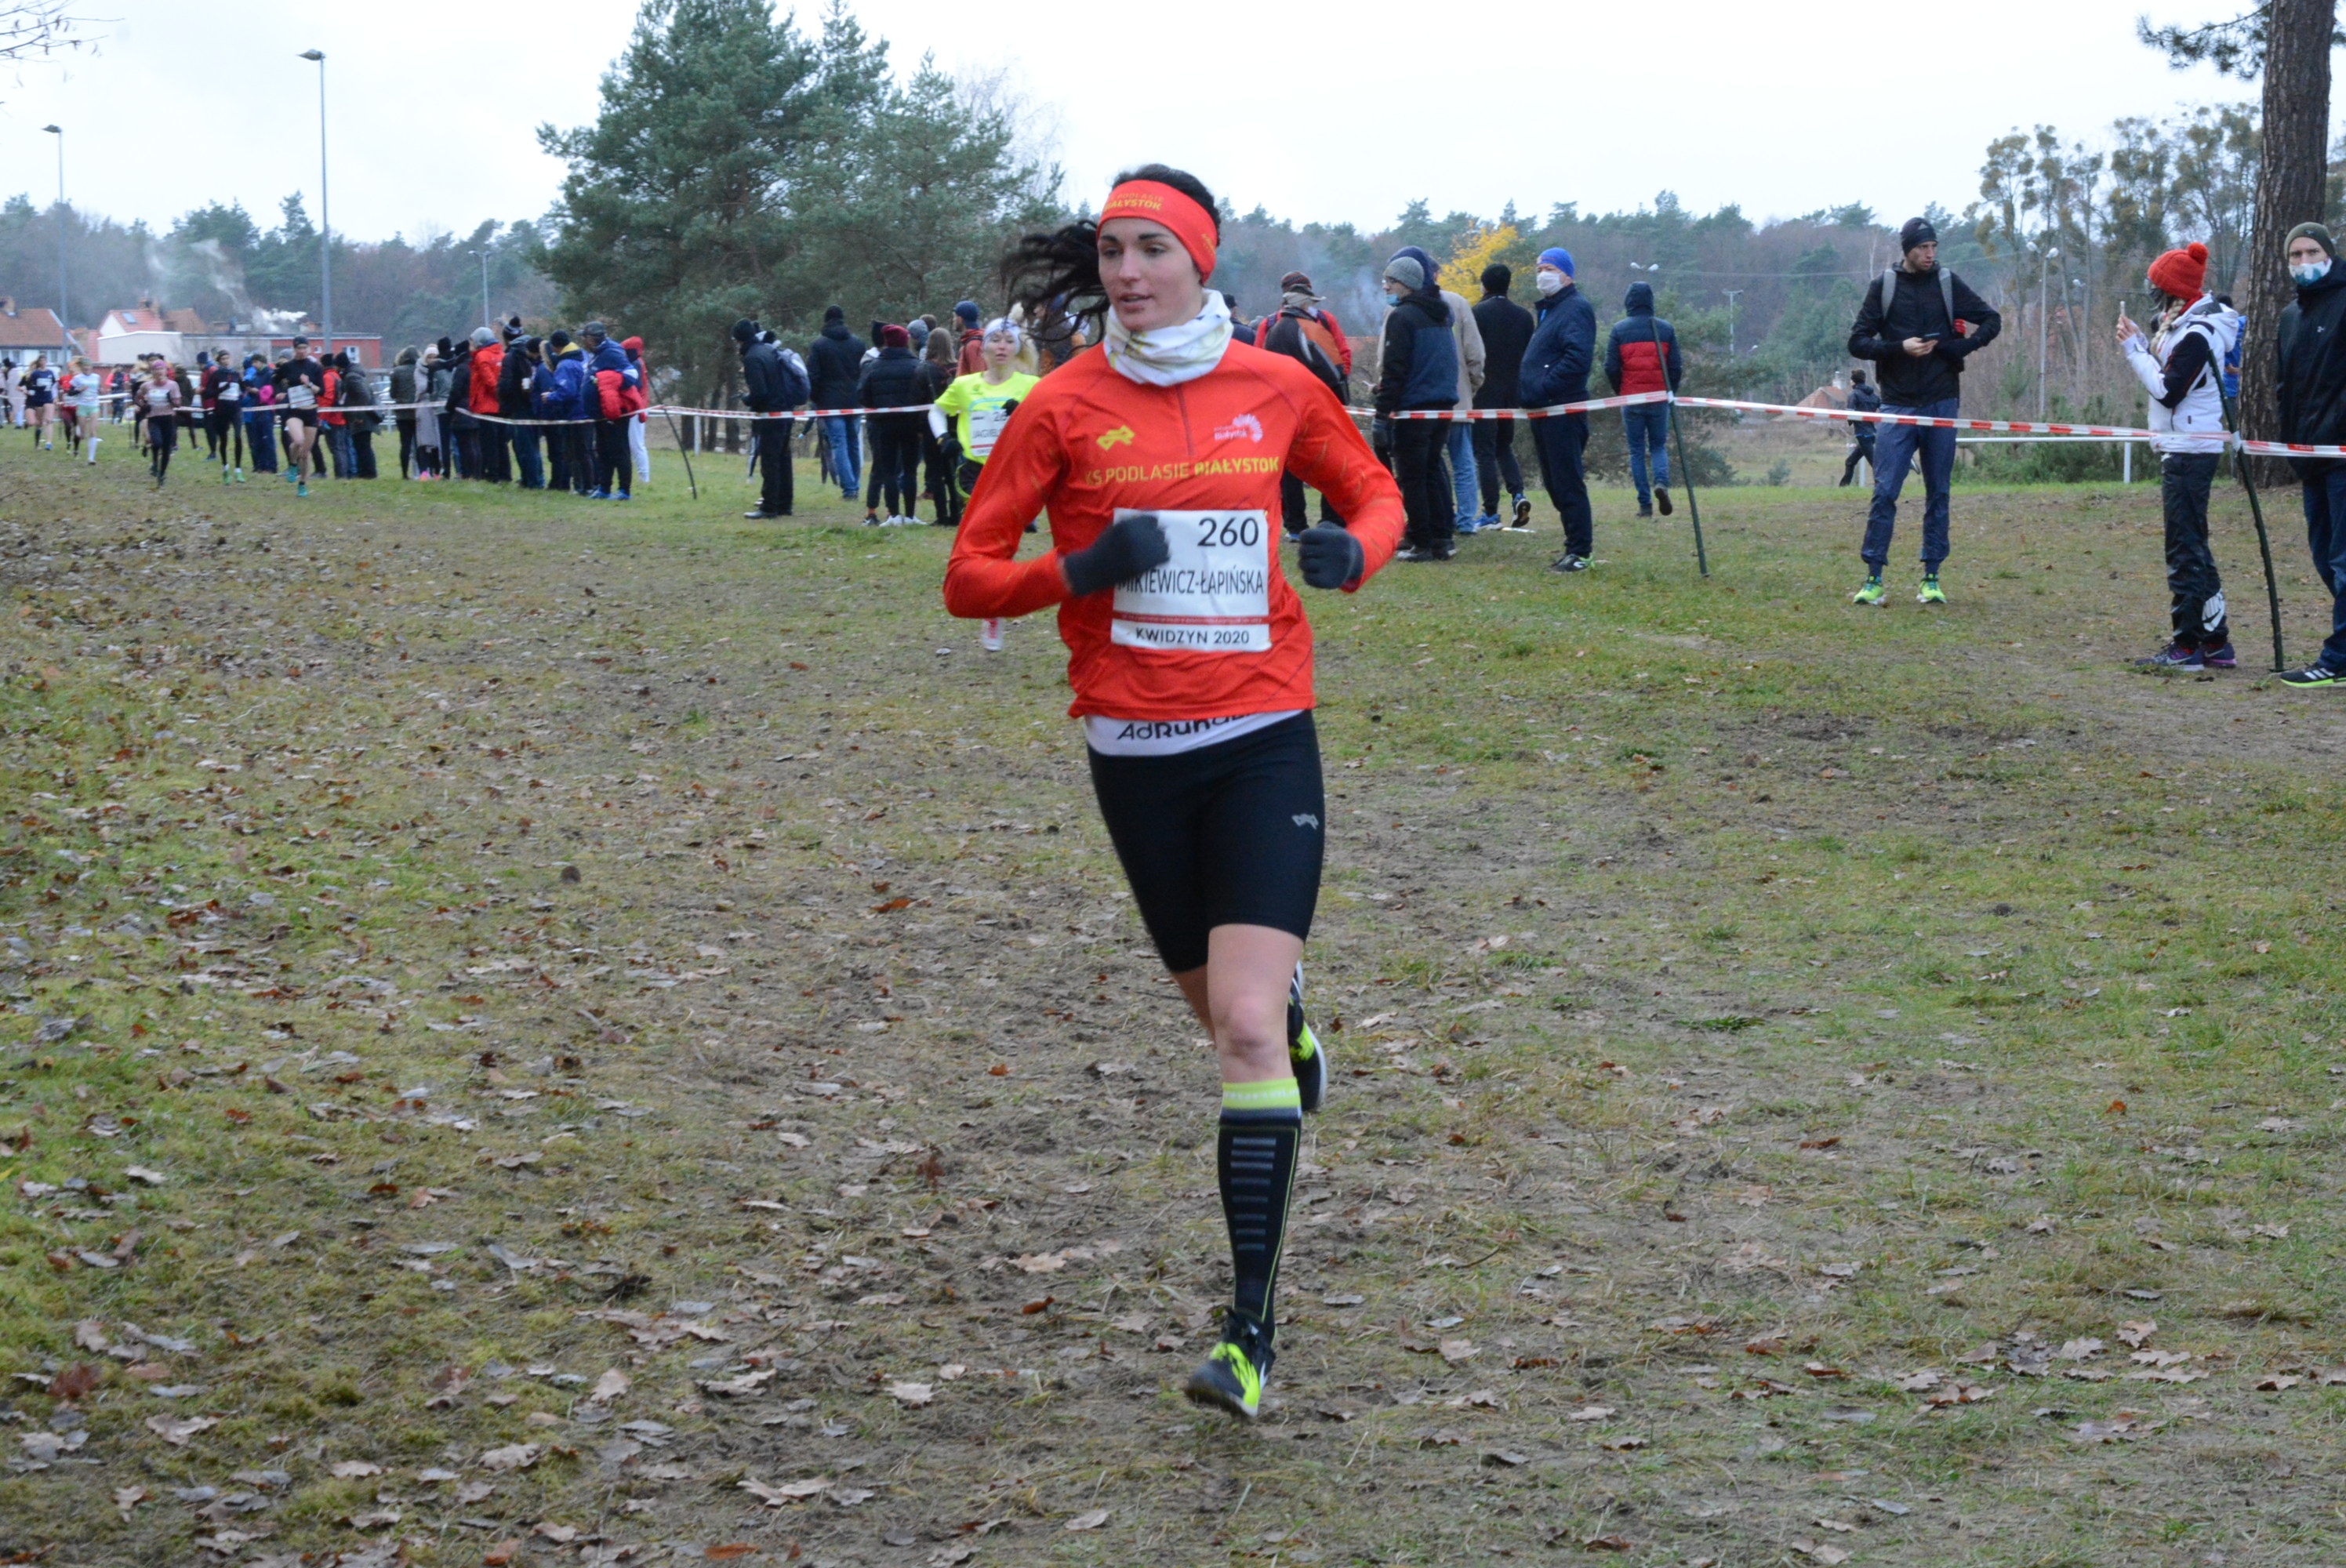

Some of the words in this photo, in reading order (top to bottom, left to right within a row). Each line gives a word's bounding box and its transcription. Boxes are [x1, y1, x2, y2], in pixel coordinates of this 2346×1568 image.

[1106, 462, 1190, 484] PODLASIE
[1194, 456, 1280, 476] BIAŁYSTOK
[1197, 517, 1259, 546] 260
[1136, 629, 1208, 644] KWIDZYN
[1214, 630, 1250, 644] 2020
